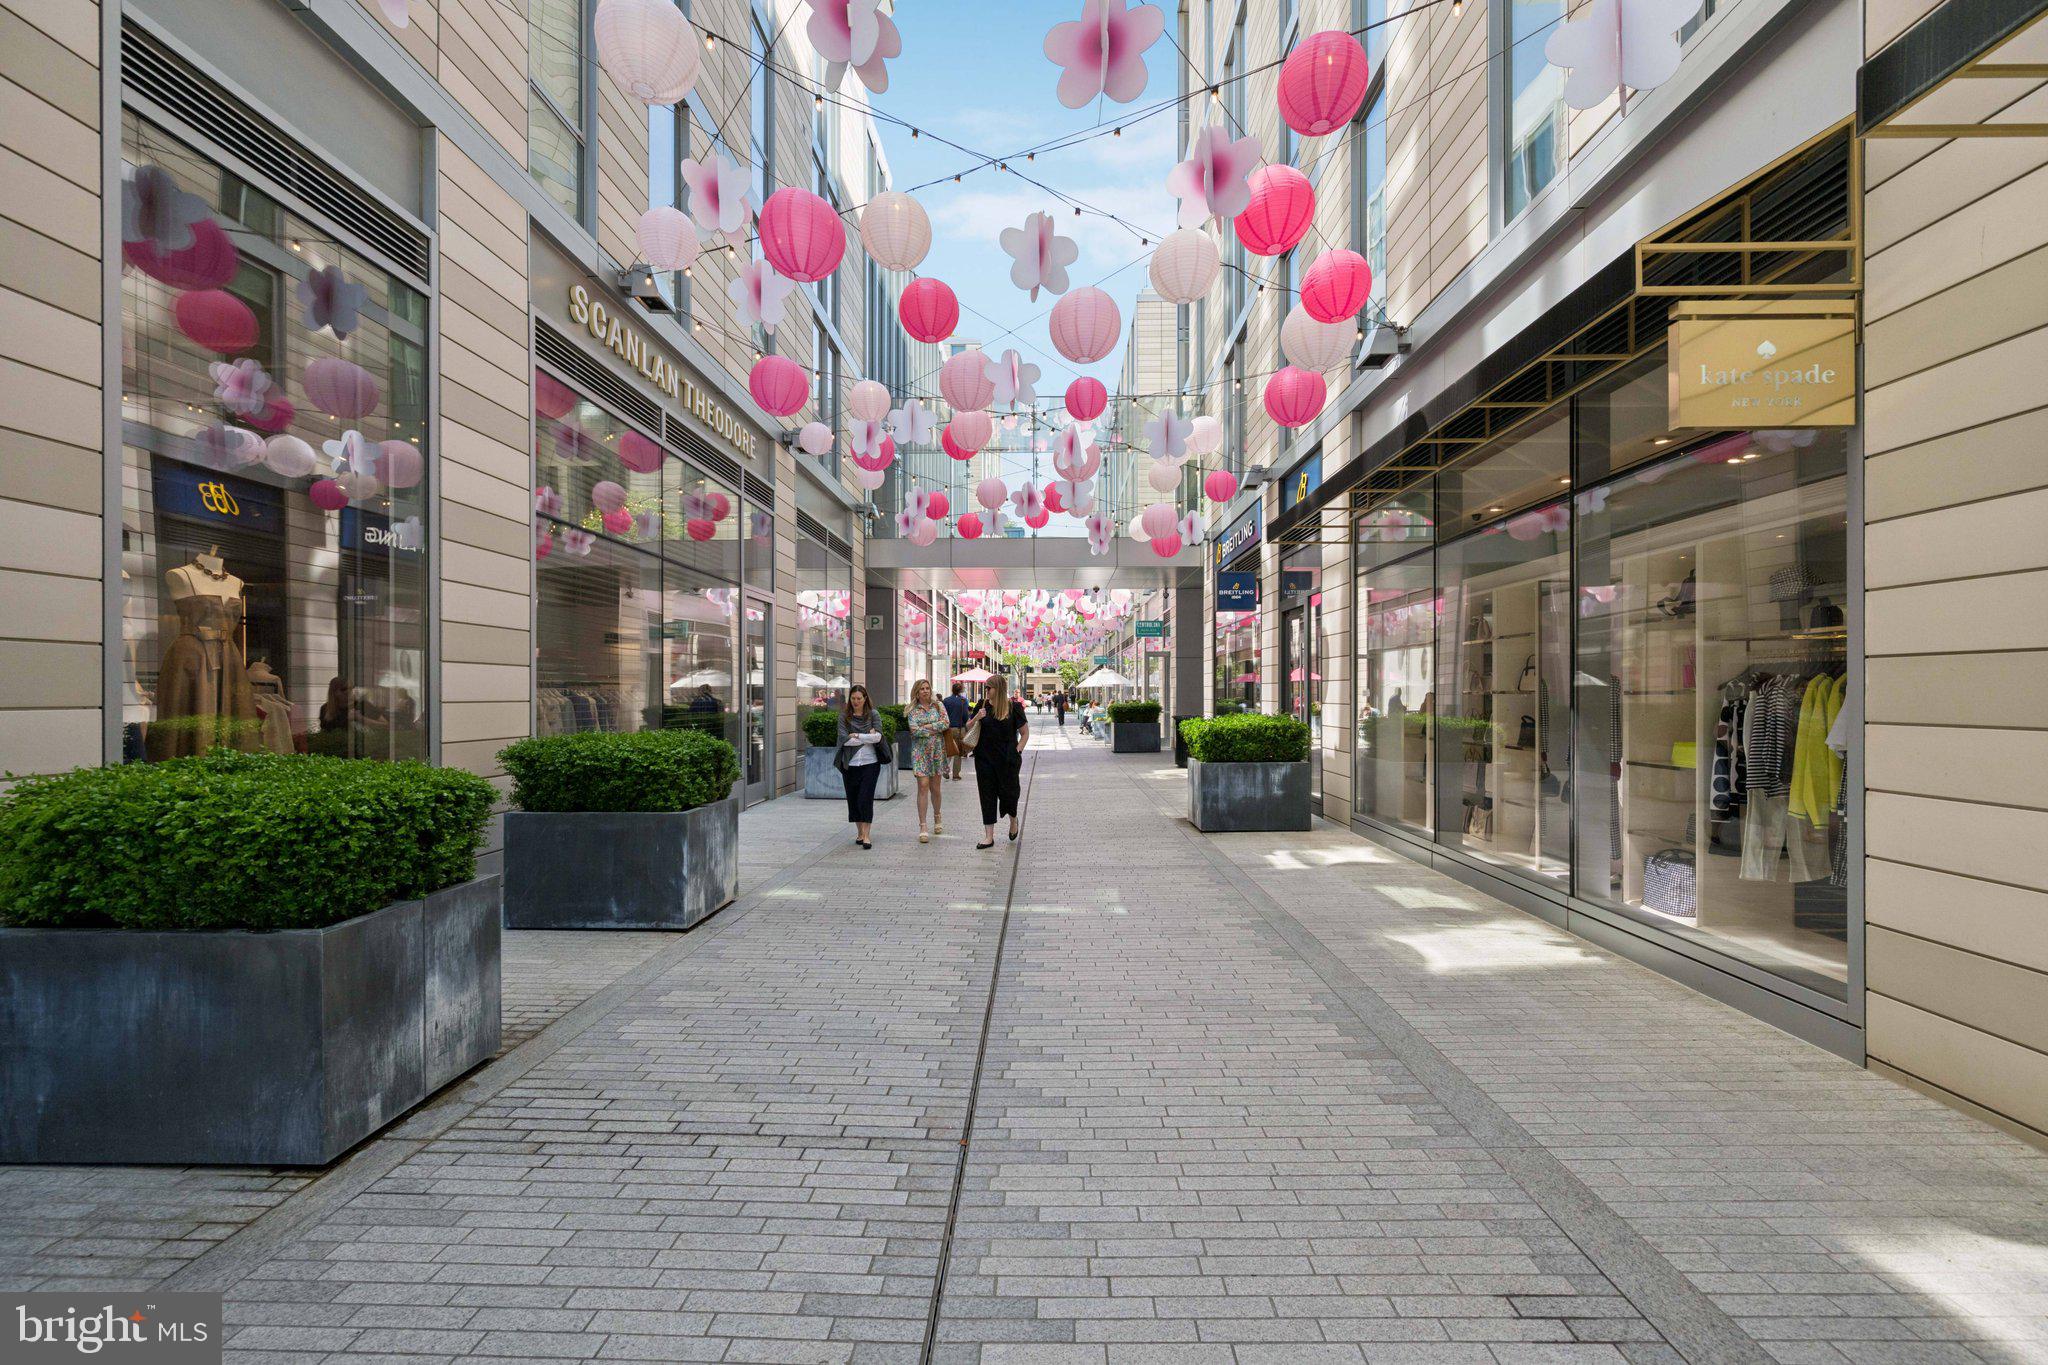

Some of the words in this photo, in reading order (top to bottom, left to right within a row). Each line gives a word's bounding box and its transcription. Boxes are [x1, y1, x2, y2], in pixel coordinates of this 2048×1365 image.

[569, 284, 678, 398] SCANLAN
[680, 377, 757, 459] THEODORE
[1699, 364, 1754, 385] kate
[1761, 364, 1836, 392] spade
[1731, 397, 1760, 408] NEW
[1767, 396, 1803, 408] YORK
[1221, 519, 1255, 558] BREITLING
[871, 616, 881, 629] P
